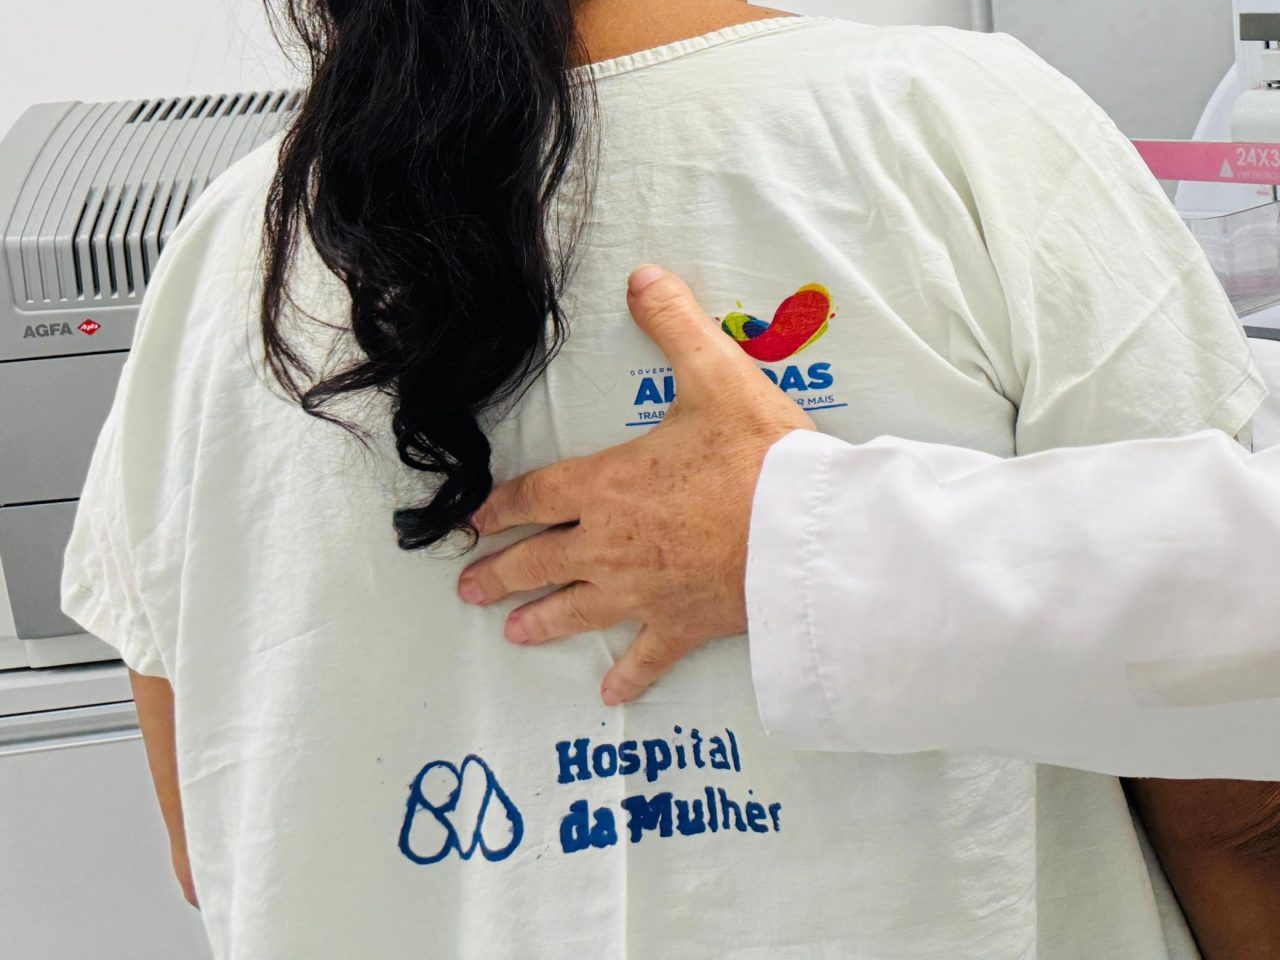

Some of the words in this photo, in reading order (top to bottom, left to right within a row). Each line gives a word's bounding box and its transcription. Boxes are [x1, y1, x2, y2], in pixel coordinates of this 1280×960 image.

[24, 322, 73, 339] AGFA
[630, 367, 673, 376] GOVERN
[638, 410, 665, 420] TRAB
[807, 394, 834, 405] MAIS
[555, 724, 741, 784] Hospital
[559, 799, 618, 854] da
[621, 786, 782, 843] Mulher
